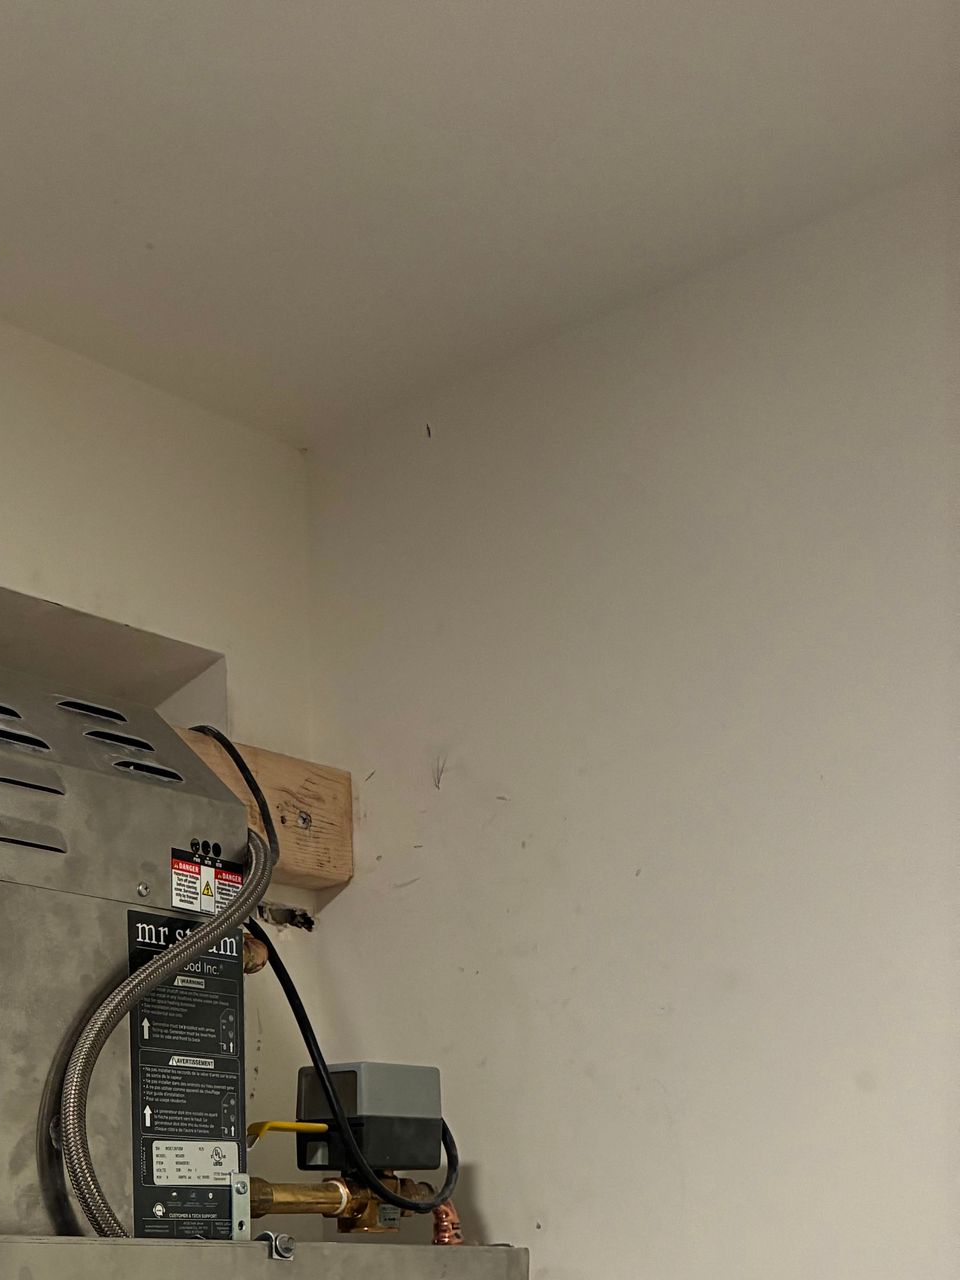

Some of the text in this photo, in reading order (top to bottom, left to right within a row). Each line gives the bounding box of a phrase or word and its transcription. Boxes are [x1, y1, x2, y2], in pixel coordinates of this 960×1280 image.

[179, 862, 199, 873] DANGER
[222, 872, 242, 883] DANGER
[135, 922, 169, 946] mr
[203, 962, 220, 975] Inc.
[179, 977, 204, 987] WARNING
[176, 1058, 214, 1067] AVERTISSEMENT
